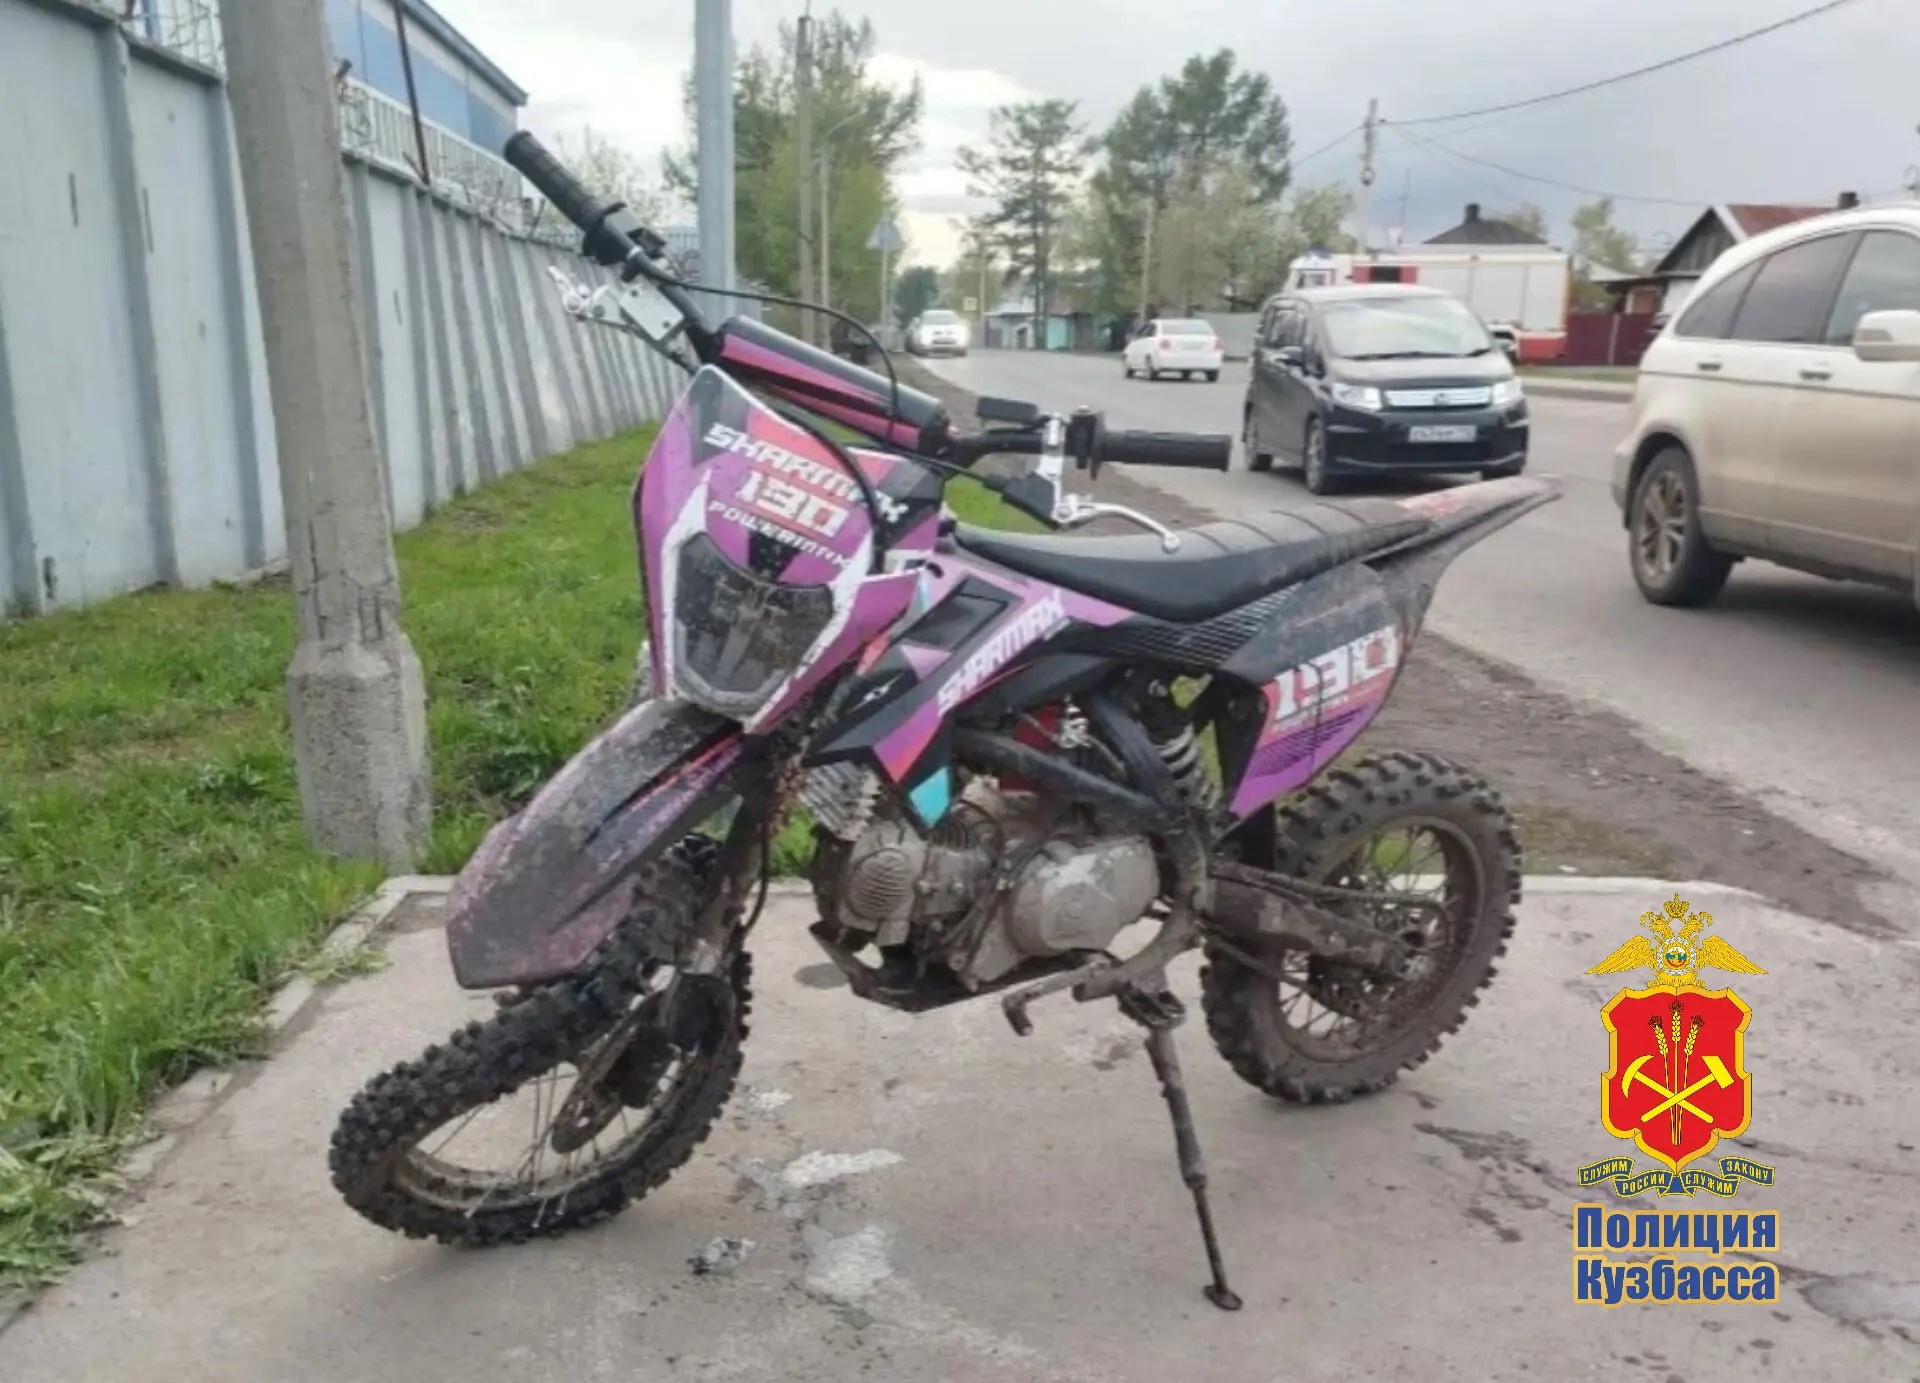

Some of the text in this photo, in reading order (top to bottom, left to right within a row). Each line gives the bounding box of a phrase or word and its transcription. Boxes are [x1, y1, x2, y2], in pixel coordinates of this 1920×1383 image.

[736, 470, 850, 538] 130
[937, 588, 1066, 717] SHARMAX
[1274, 624, 1398, 720] 130
